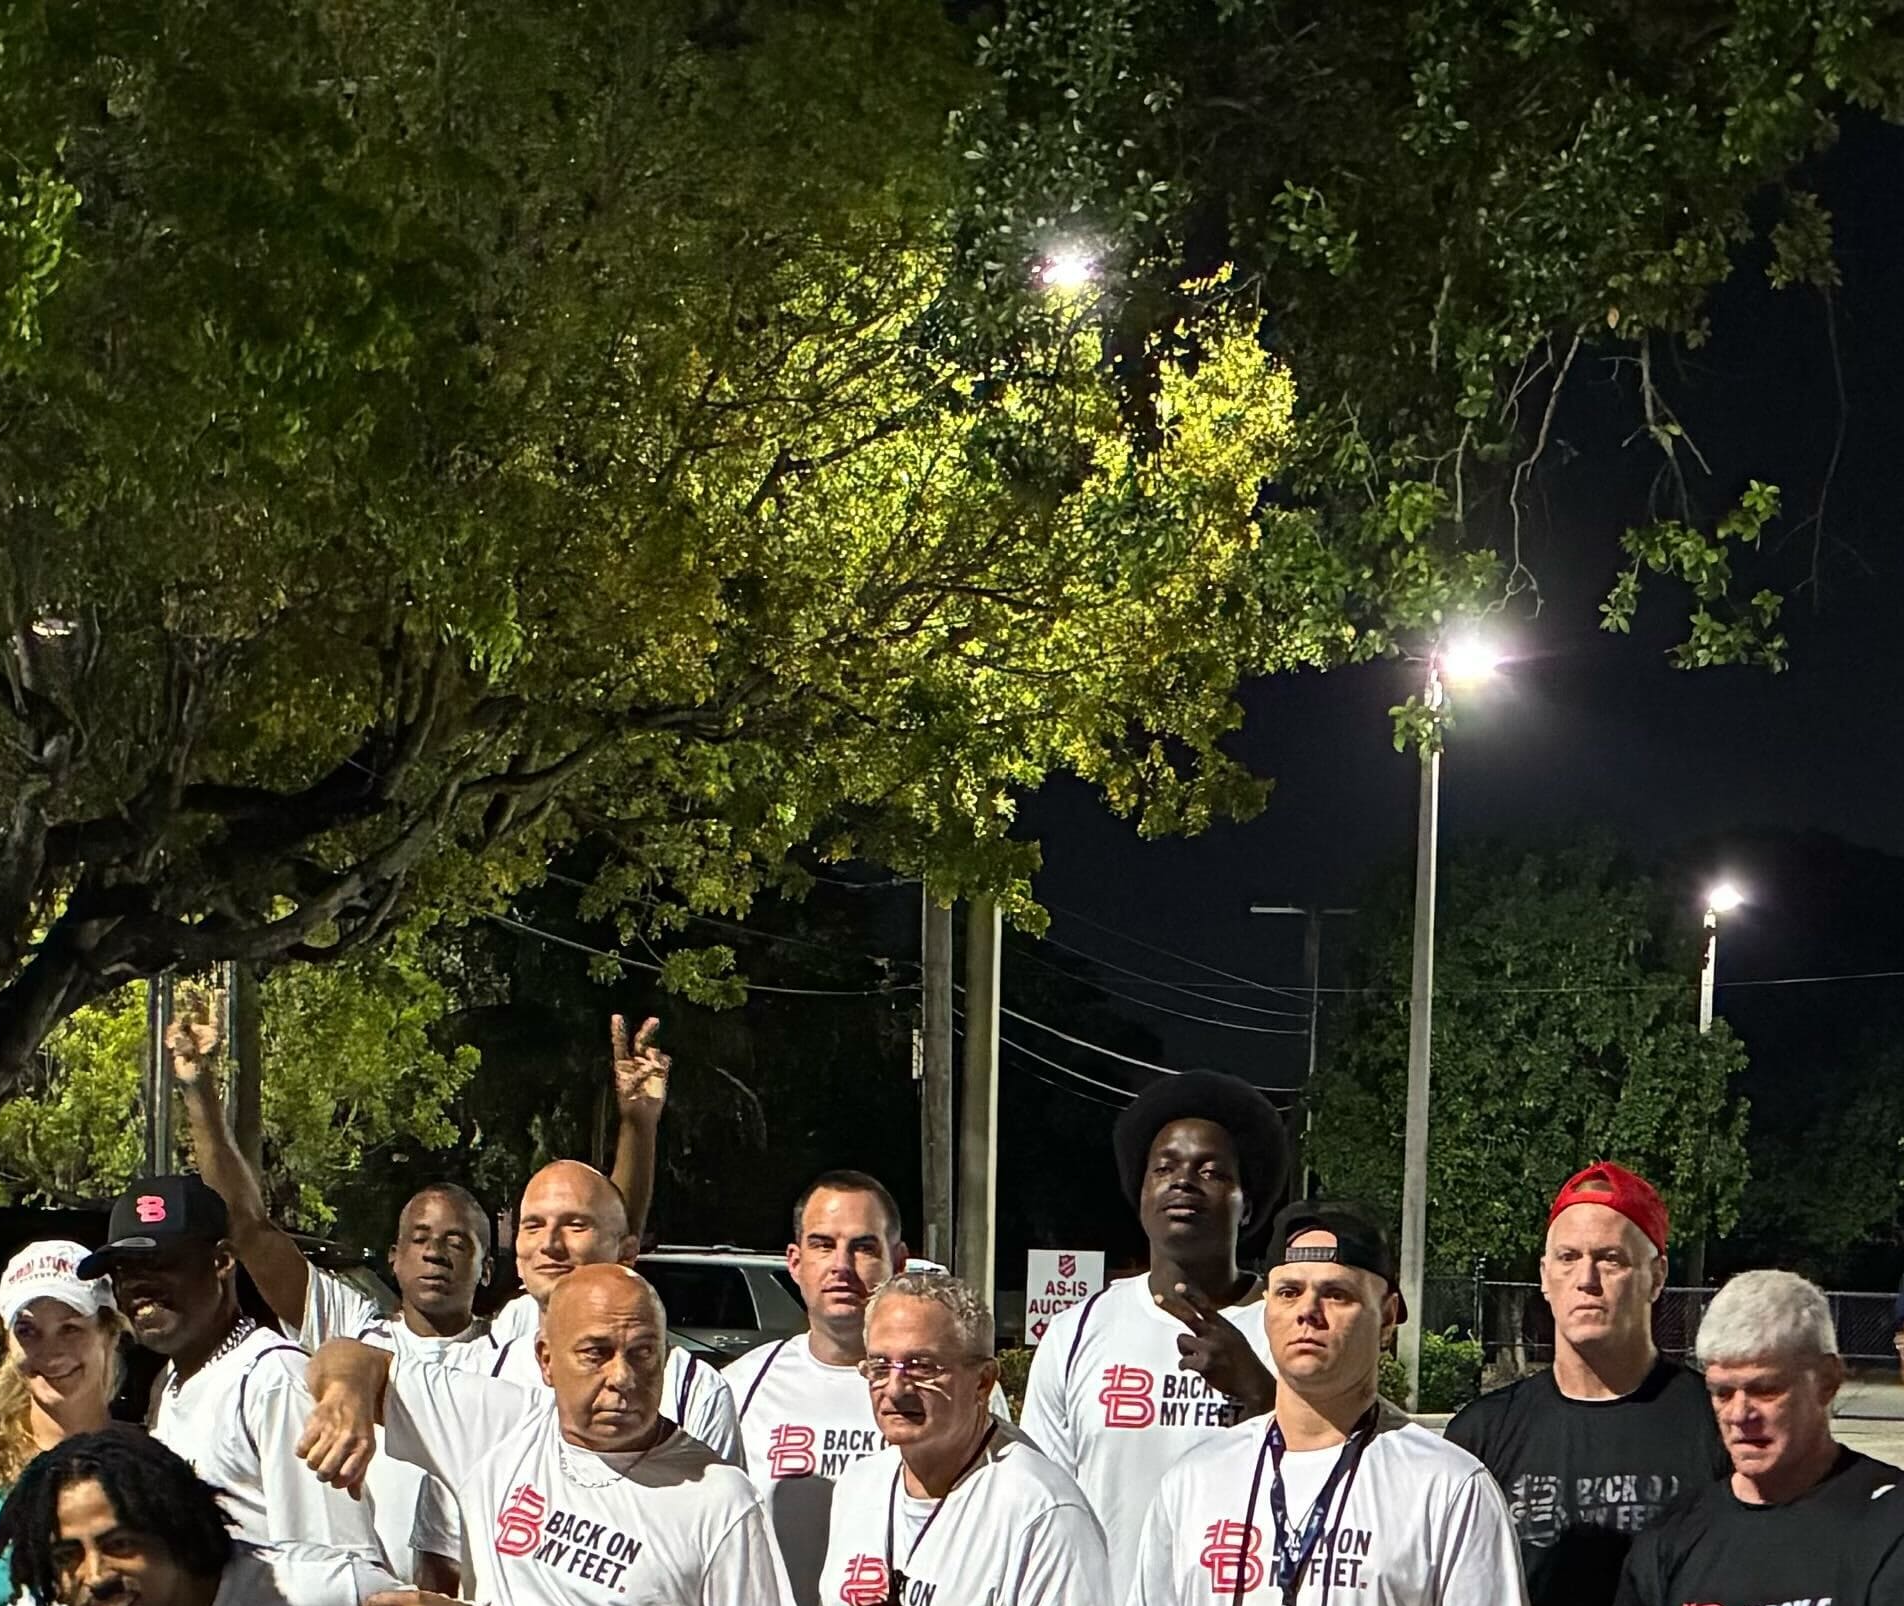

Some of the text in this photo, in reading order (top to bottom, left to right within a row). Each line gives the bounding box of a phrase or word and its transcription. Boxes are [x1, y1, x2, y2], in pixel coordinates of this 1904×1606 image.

[1045, 1280, 1088, 1297] AS-IS
[1028, 1299, 1080, 1315] AUCT
[1159, 1401, 1191, 1427] MY
[823, 1429, 876, 1452] BACK
[820, 1453, 851, 1477] MY
[545, 1510, 643, 1565] BACK ON
[1338, 1528, 1372, 1556] ON
[533, 1535, 571, 1567] MY
[1308, 1557, 1369, 1590] FET.
